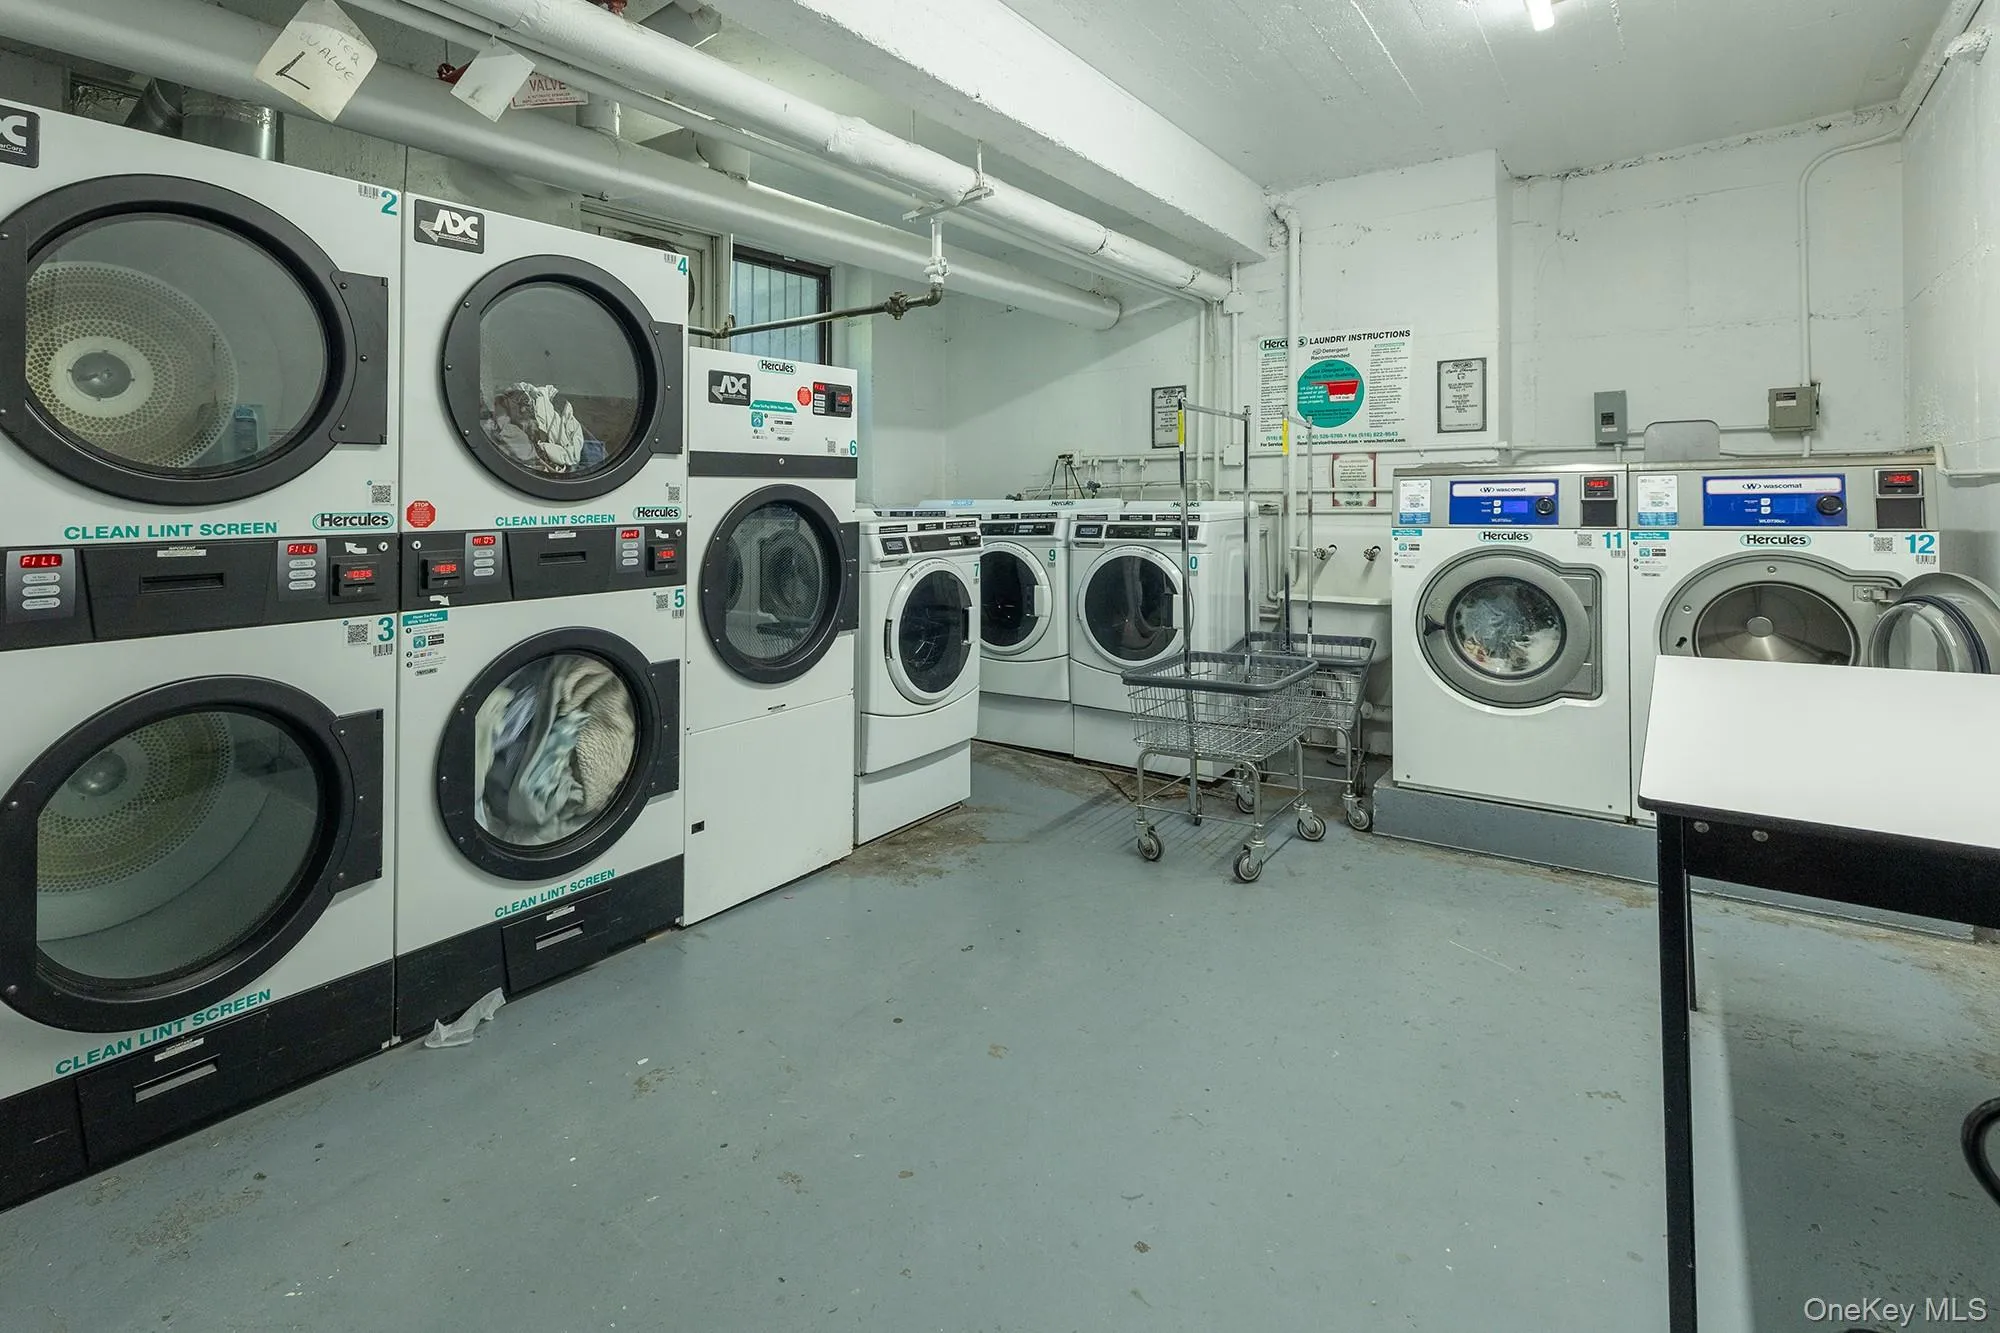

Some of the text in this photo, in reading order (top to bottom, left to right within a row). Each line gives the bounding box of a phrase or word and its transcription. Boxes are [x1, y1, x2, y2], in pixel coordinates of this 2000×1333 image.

[529, 79, 566, 91] VALVE
[381, 190, 397, 215] 2
[433, 209, 478, 240] ADC
[677, 256, 688, 276] 4
[1264, 330, 1410, 348] Hercus LAUNDRY INSTRUCTIONS
[761, 360, 794, 373] Hercules
[720, 375, 747, 396] ADC
[849, 440, 857, 456] 6
[1763, 482, 1803, 490] wascomat
[320, 513, 389, 527] Hercules
[495, 514, 615, 527] CLEAN LINT SCREEN
[638, 507, 679, 518] Hercules
[64, 521, 278, 540] CLEAN LINT SCREEN
[1483, 531, 1529, 541] Hercules
[1602, 531, 1622, 549] 11
[1746, 534, 1807, 546] Hercules
[1905, 534, 1935, 554] 12
[288, 544, 315, 554] FILL
[1048, 548, 1056, 561] 9
[974, 563, 979, 577] 7
[674, 588, 685, 609] 5
[377, 616, 394, 642] 3
[495, 895, 537, 918] CLEAN
[541, 884, 567, 903] LINT
[570, 868, 615, 892] SCREEN
[55, 1037, 132, 1075] CLEAN
[140, 1018, 186, 1047] LINT
[192, 988, 271, 1027] SCREEN
